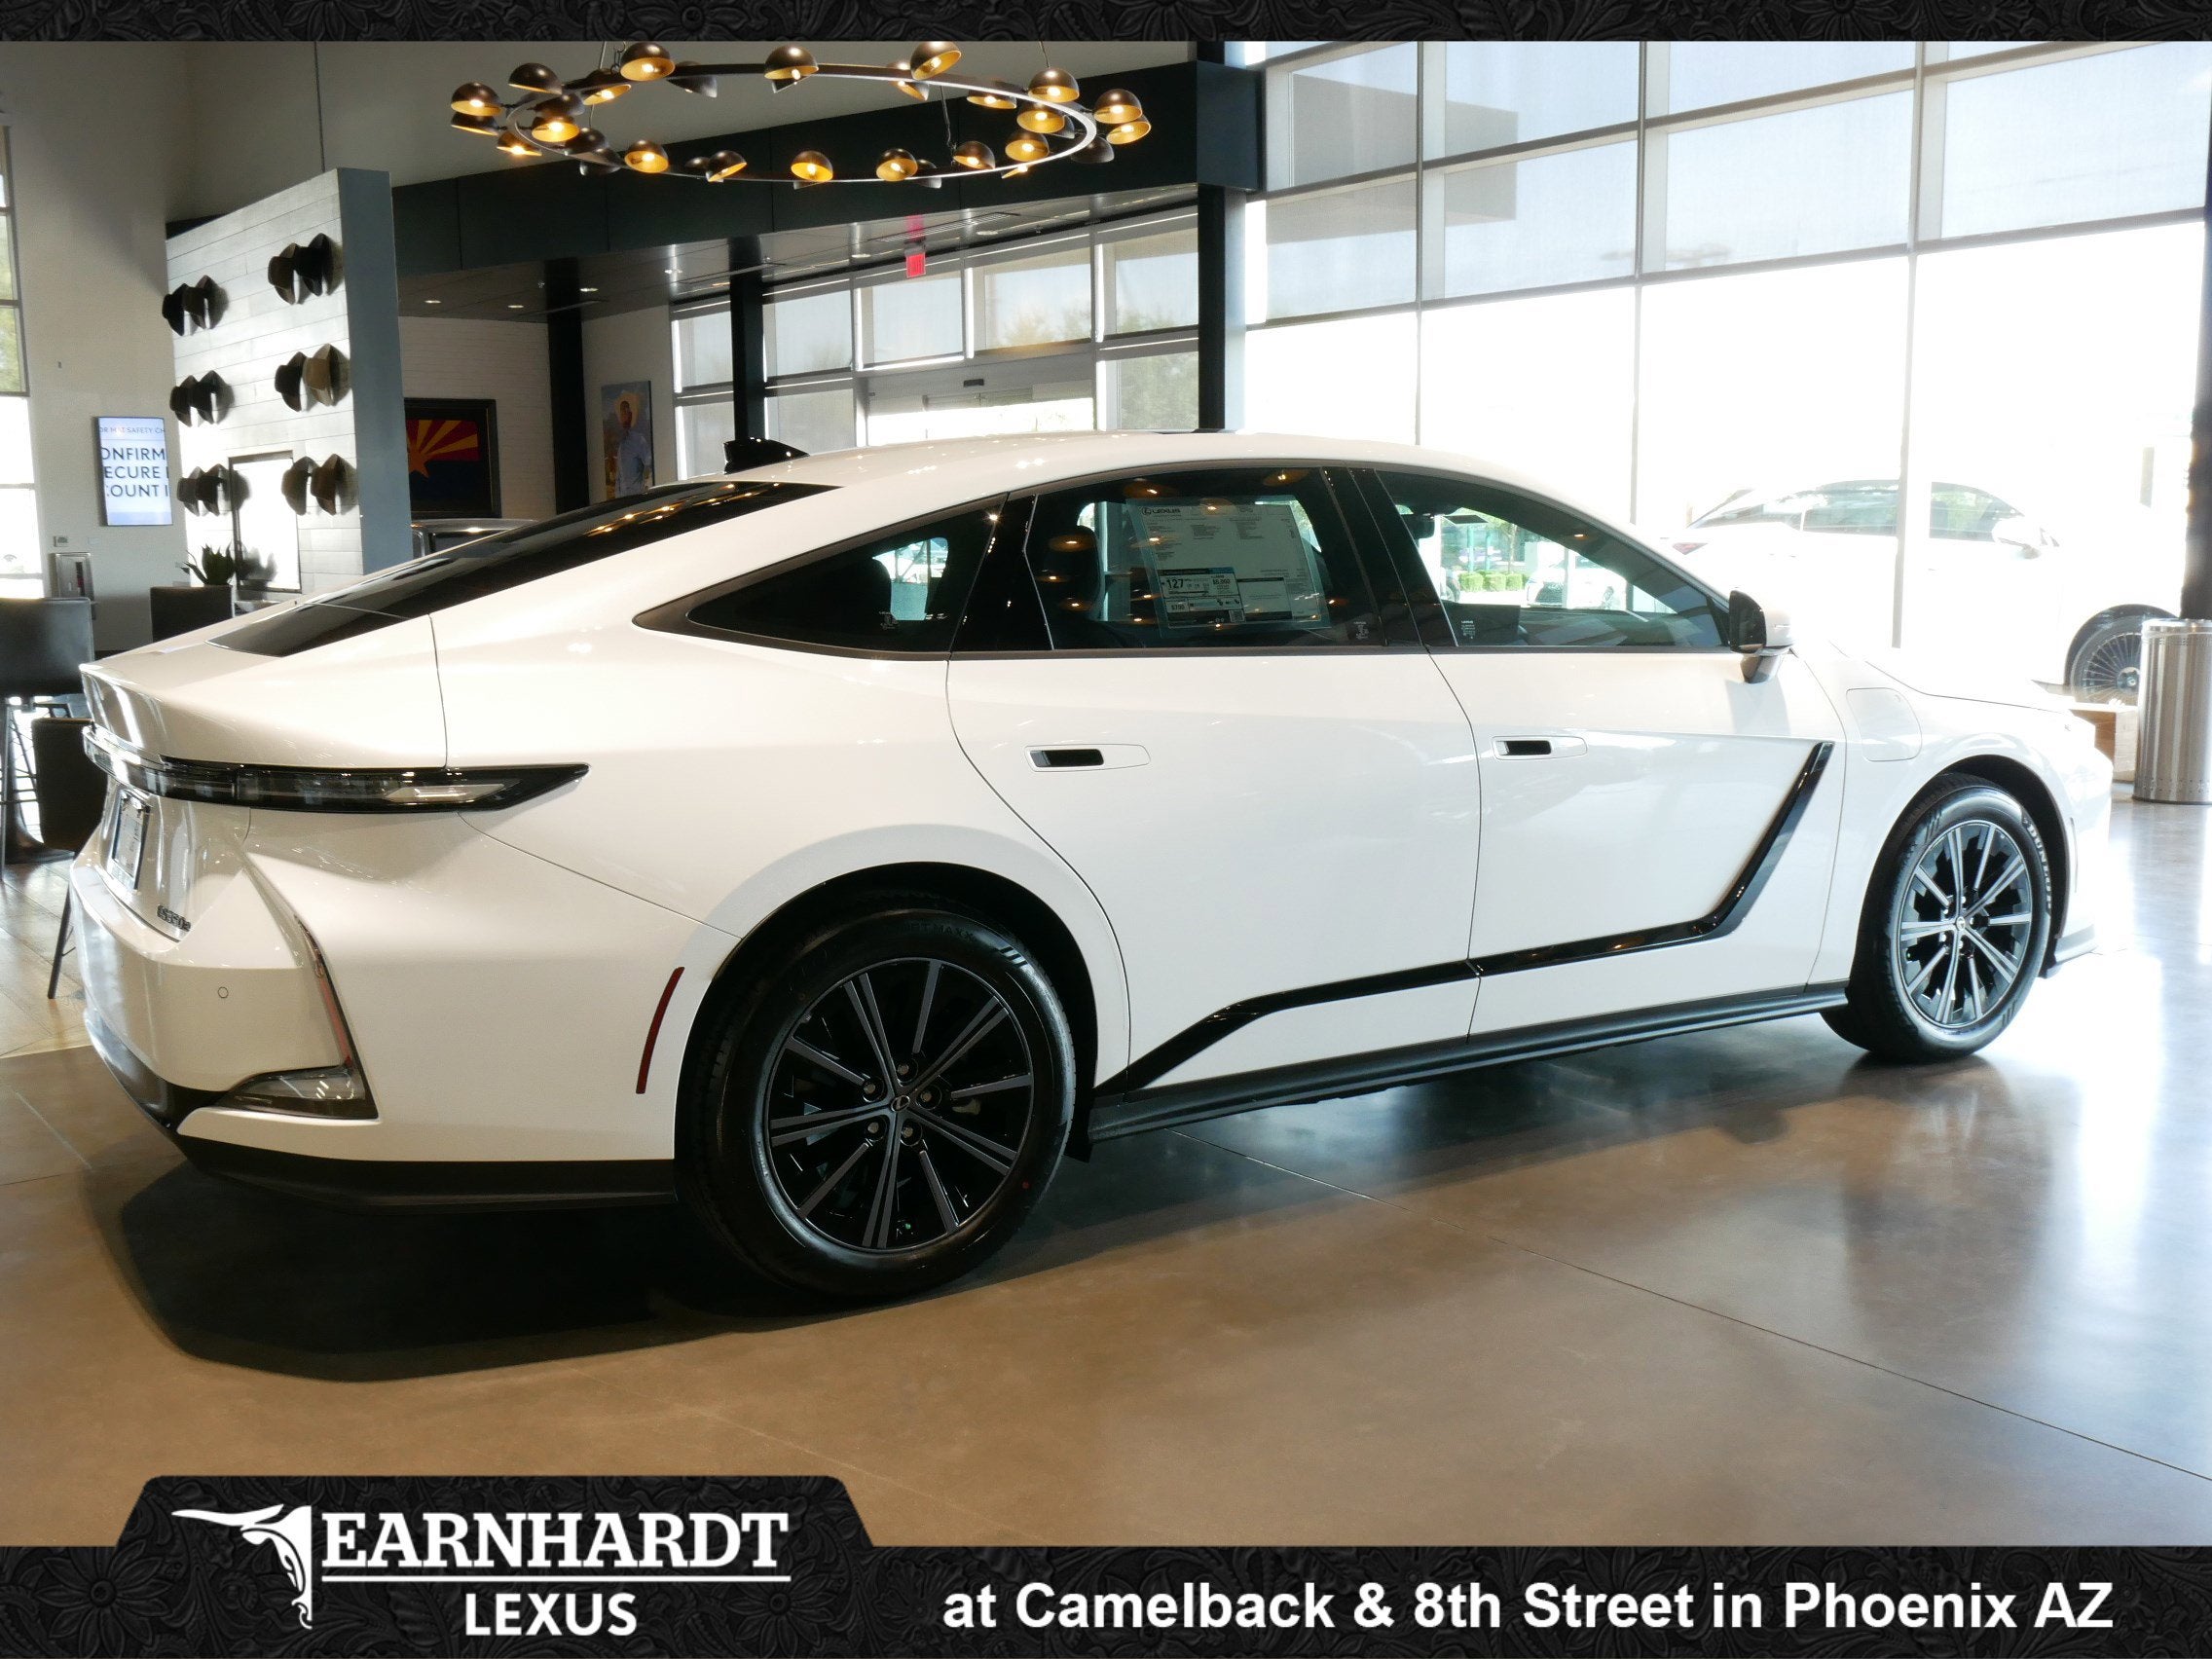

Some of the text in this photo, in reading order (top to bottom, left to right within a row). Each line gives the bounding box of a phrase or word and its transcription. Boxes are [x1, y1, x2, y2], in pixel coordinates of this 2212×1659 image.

[104, 466, 161, 478] ECURE
[106, 485, 160, 498] OUNT
[1166, 578, 1184, 589] 127
